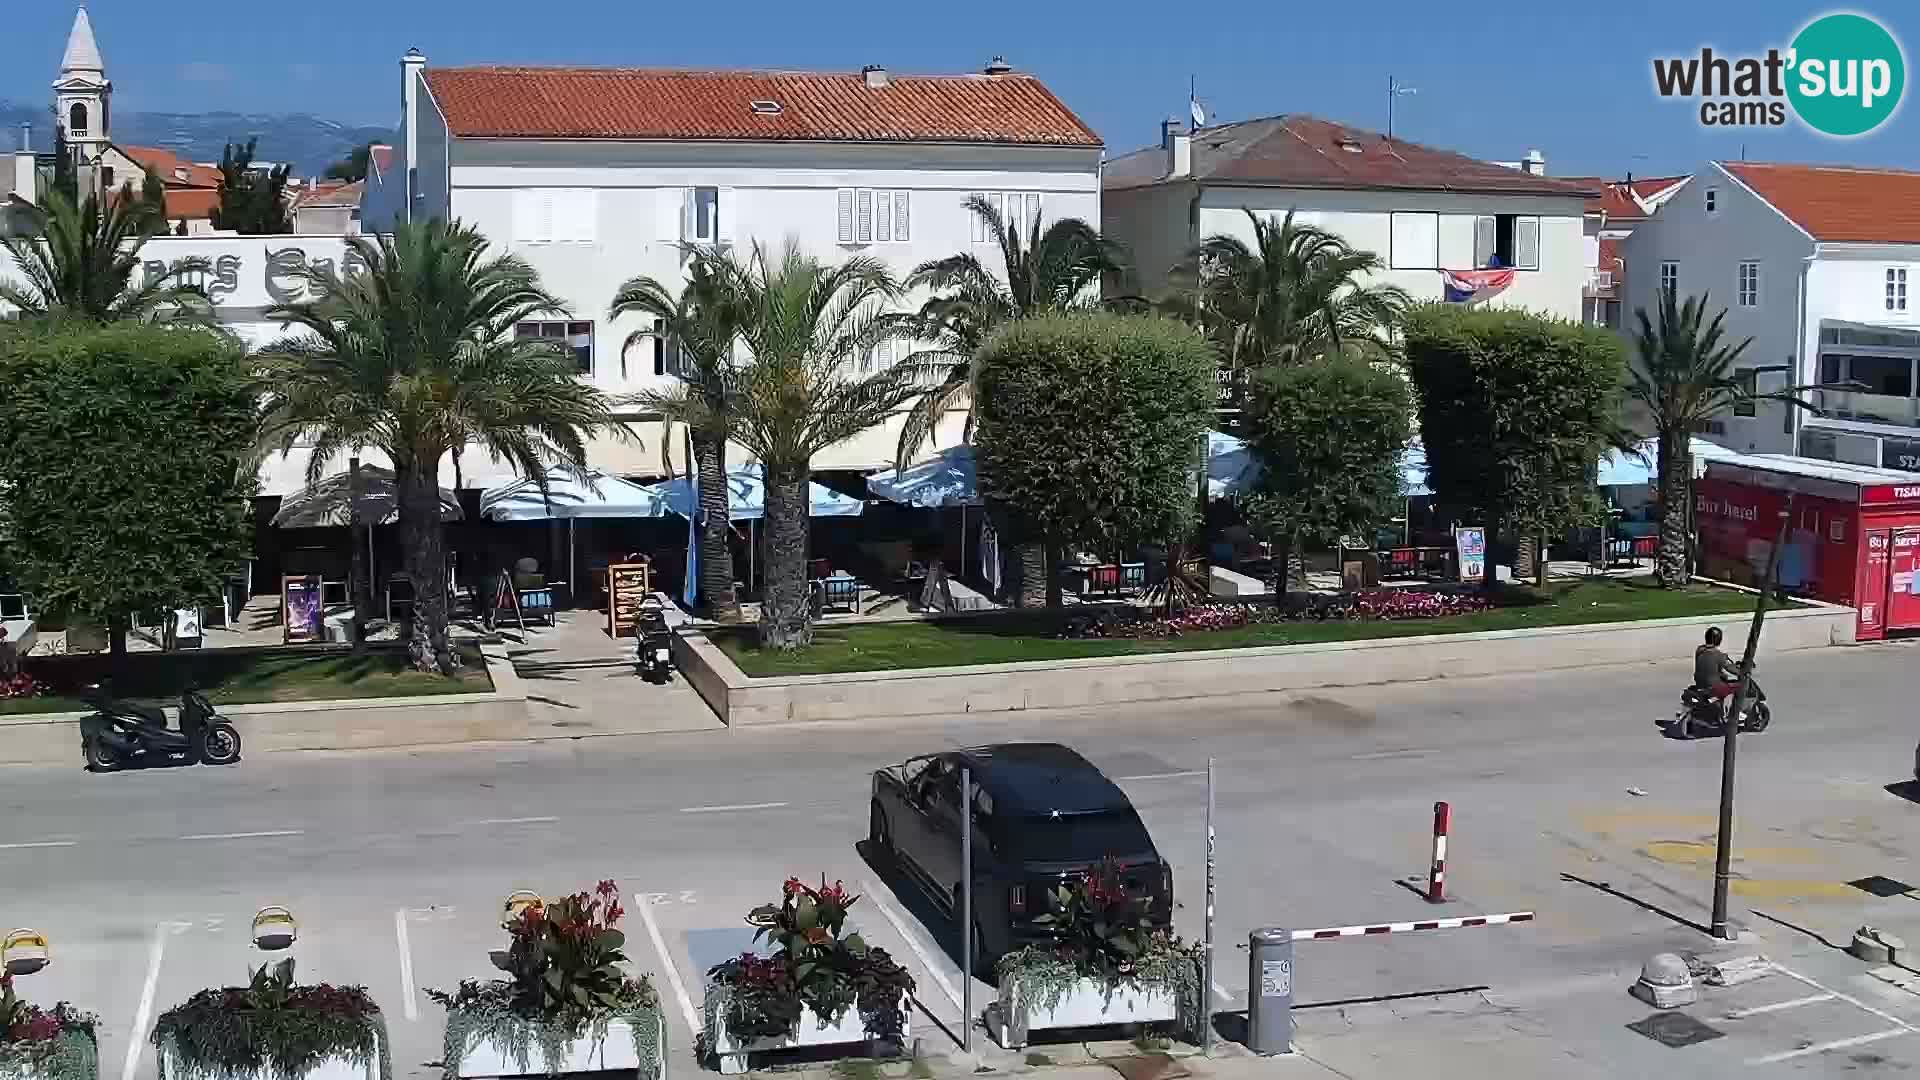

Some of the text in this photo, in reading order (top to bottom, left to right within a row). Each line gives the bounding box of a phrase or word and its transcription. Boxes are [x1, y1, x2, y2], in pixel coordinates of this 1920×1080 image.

[1893, 487, 1920, 498] TISA
[1696, 494, 1719, 514] Buy
[1869, 535, 1889, 550] Buy
